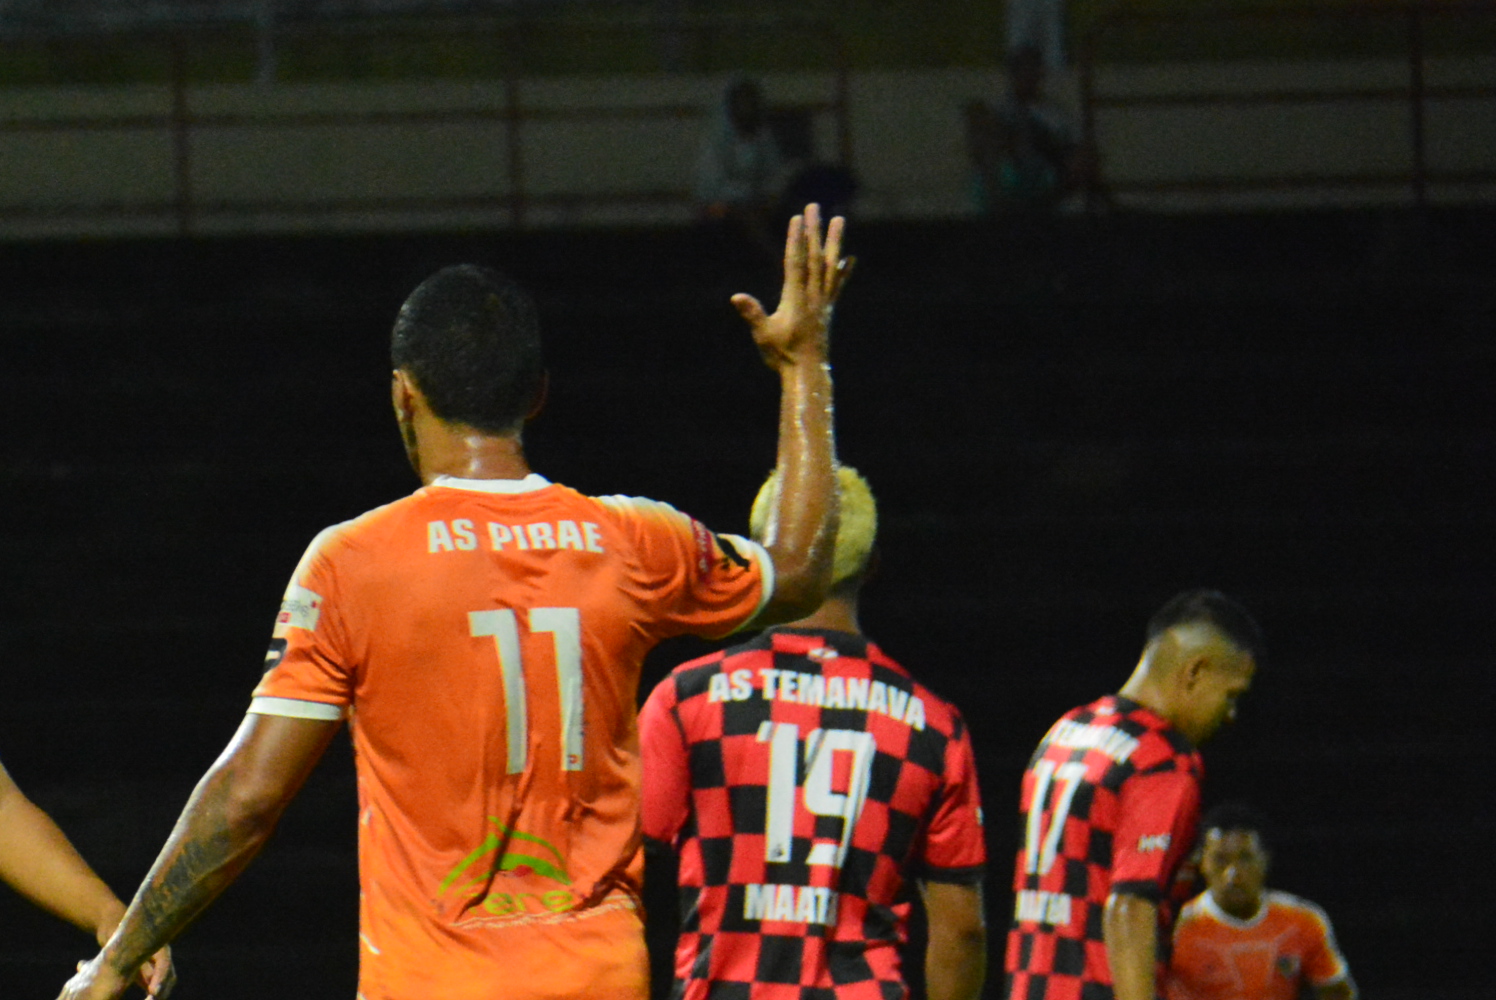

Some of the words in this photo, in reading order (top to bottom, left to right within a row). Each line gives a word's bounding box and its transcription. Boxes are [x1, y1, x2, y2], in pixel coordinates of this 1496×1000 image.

[427, 518, 479, 553] AS
[487, 520, 605, 554] PIRAE
[468, 606, 582, 775] 11
[708, 668, 754, 703] AS
[758, 668, 926, 732] TEMANAVA
[756, 720, 877, 869] 19
[1025, 758, 1089, 876] 17
